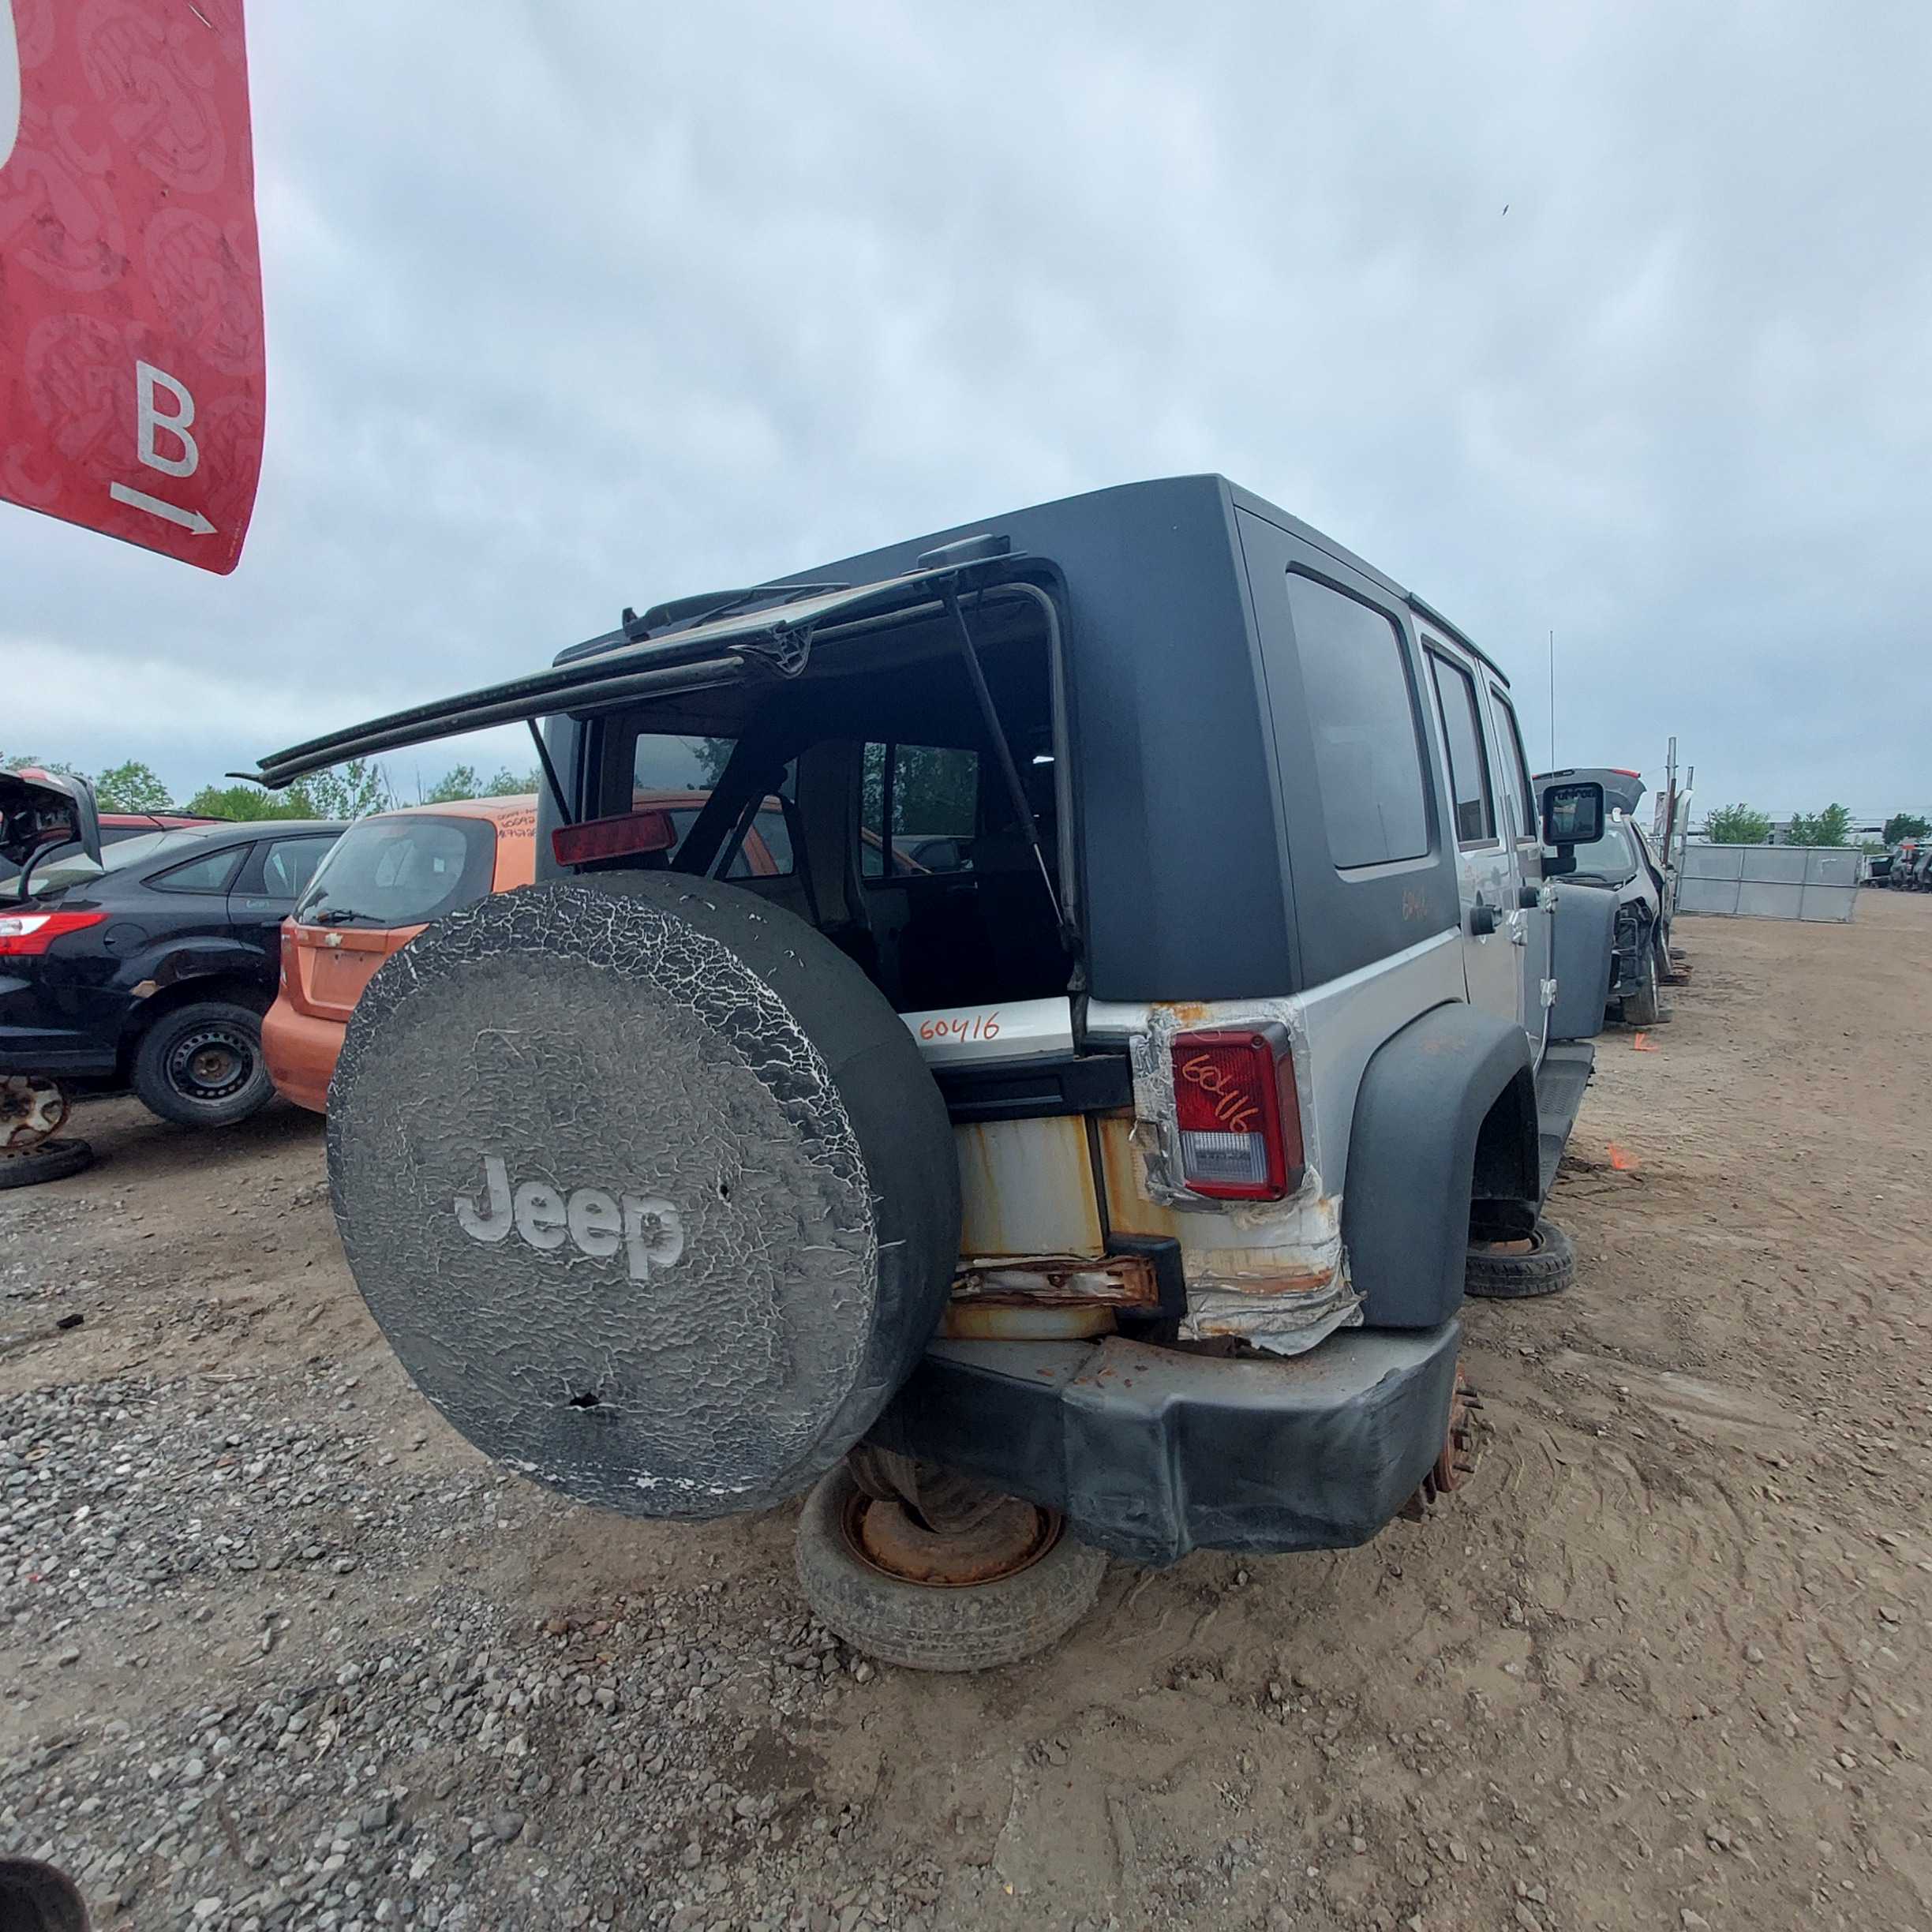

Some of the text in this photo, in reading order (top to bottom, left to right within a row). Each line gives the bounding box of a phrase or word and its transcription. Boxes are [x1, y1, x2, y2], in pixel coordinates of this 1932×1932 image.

[136, 359, 199, 478] B
[919, 1011, 1000, 1044] 60416
[454, 1155, 683, 1280] Jeep
